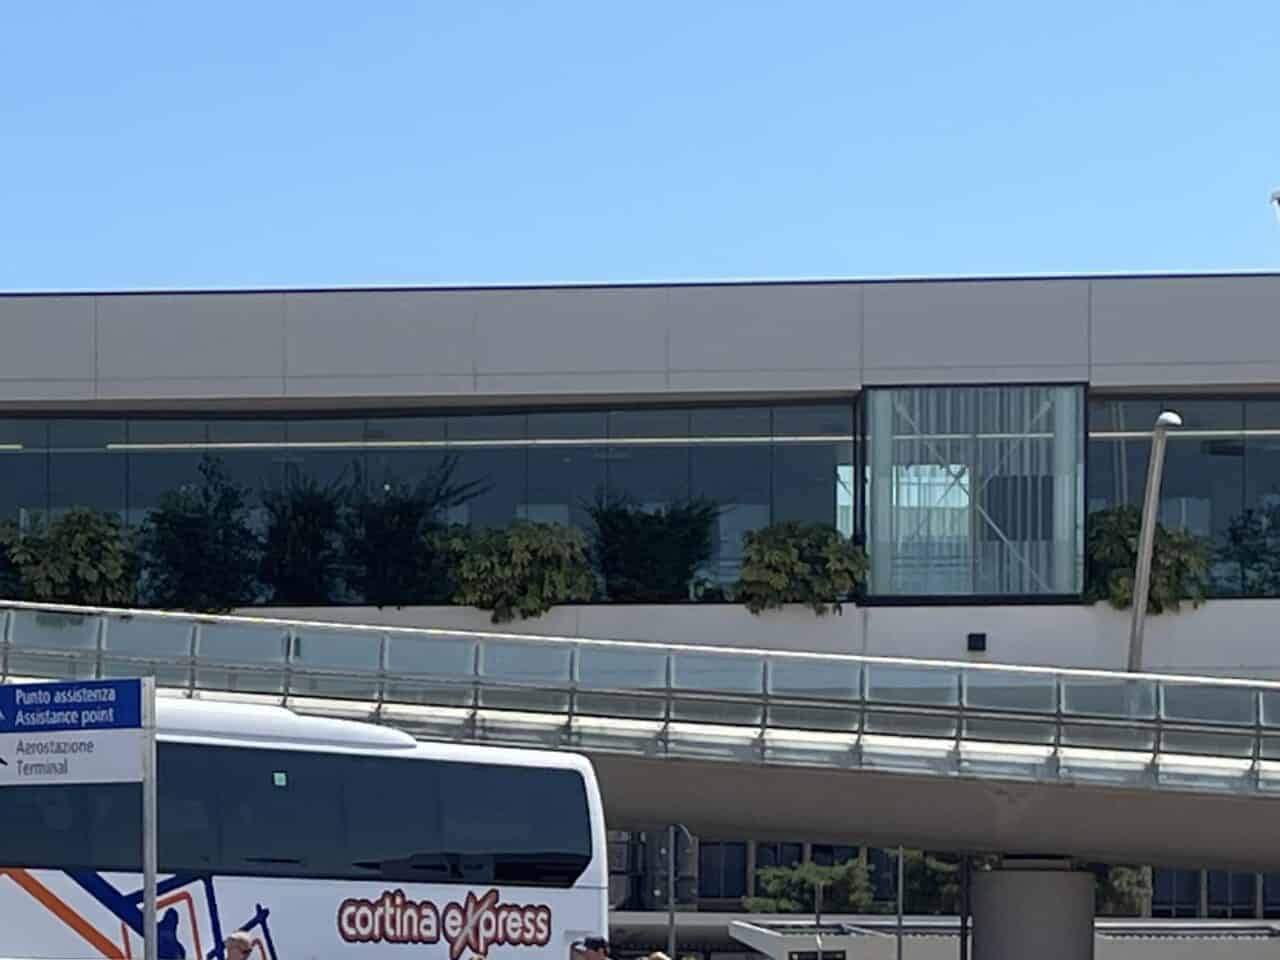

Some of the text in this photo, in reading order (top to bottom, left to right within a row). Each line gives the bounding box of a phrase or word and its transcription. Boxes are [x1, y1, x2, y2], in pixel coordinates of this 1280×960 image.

[15, 687, 116, 705] Punto assistenza
[15, 707, 114, 727] Assistance point
[15, 738, 95, 756] Aerostazione
[17, 759, 68, 776] Terminal
[339, 890, 441, 943] cortina
